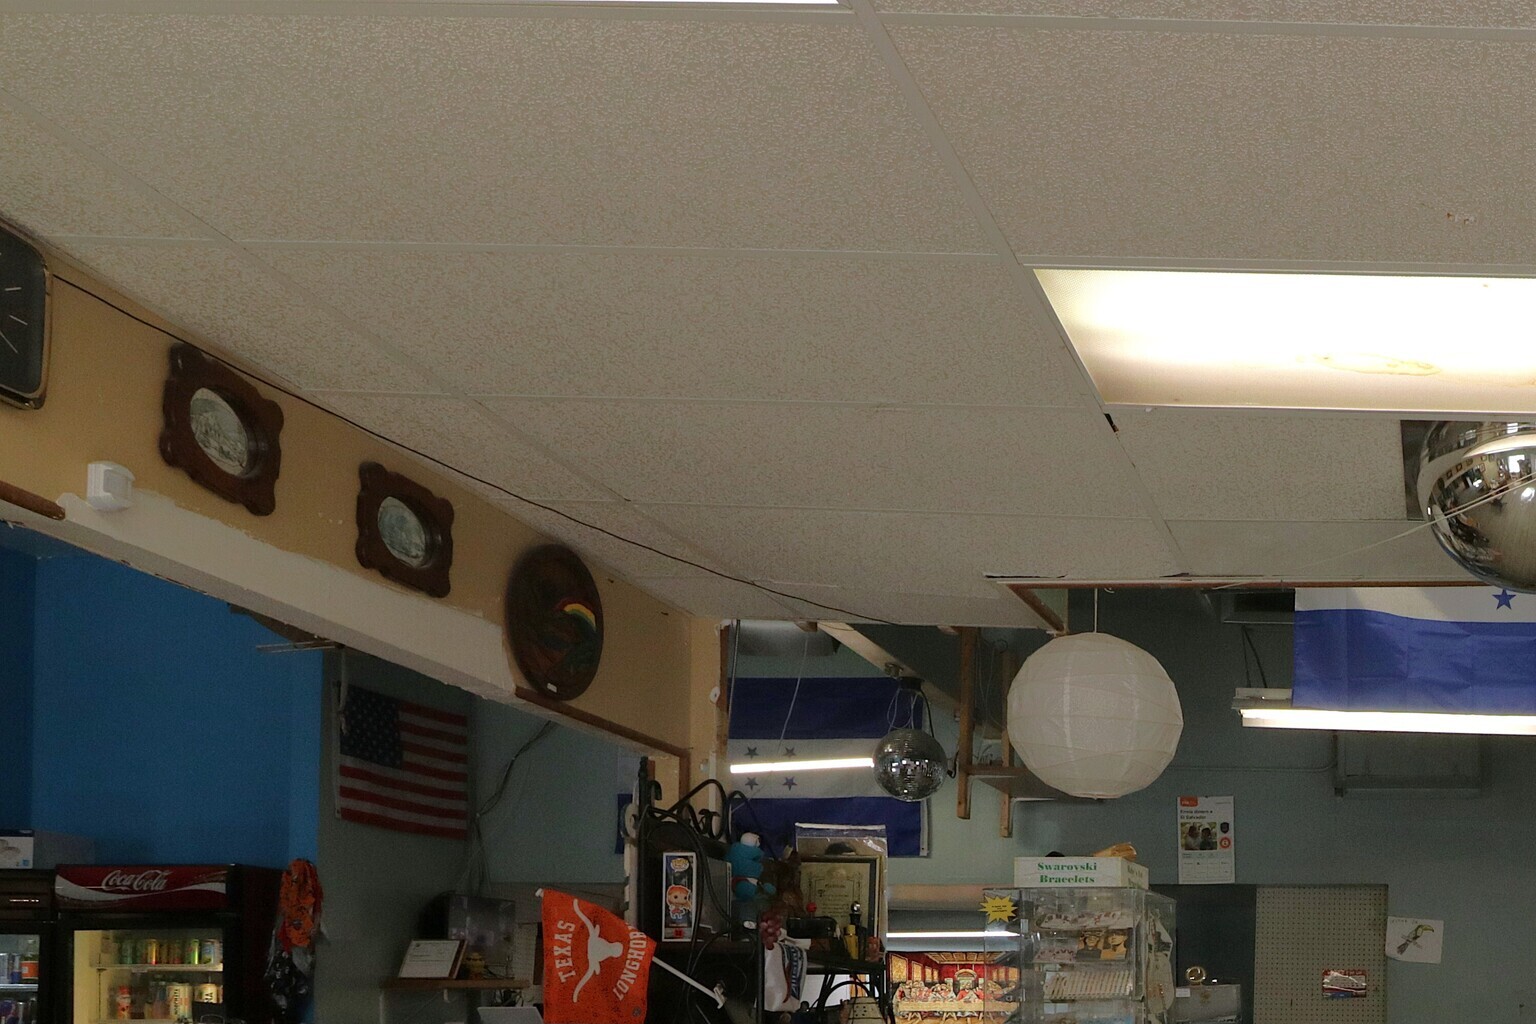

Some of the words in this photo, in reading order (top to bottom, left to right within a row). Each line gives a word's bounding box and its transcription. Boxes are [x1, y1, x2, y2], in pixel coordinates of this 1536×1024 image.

[1037, 862, 1098, 871] Swarovski
[1039, 874, 1096, 883] Bracelets
[553, 920, 577, 983] TEXAS
[612, 922, 648, 1001] LONGHOR
